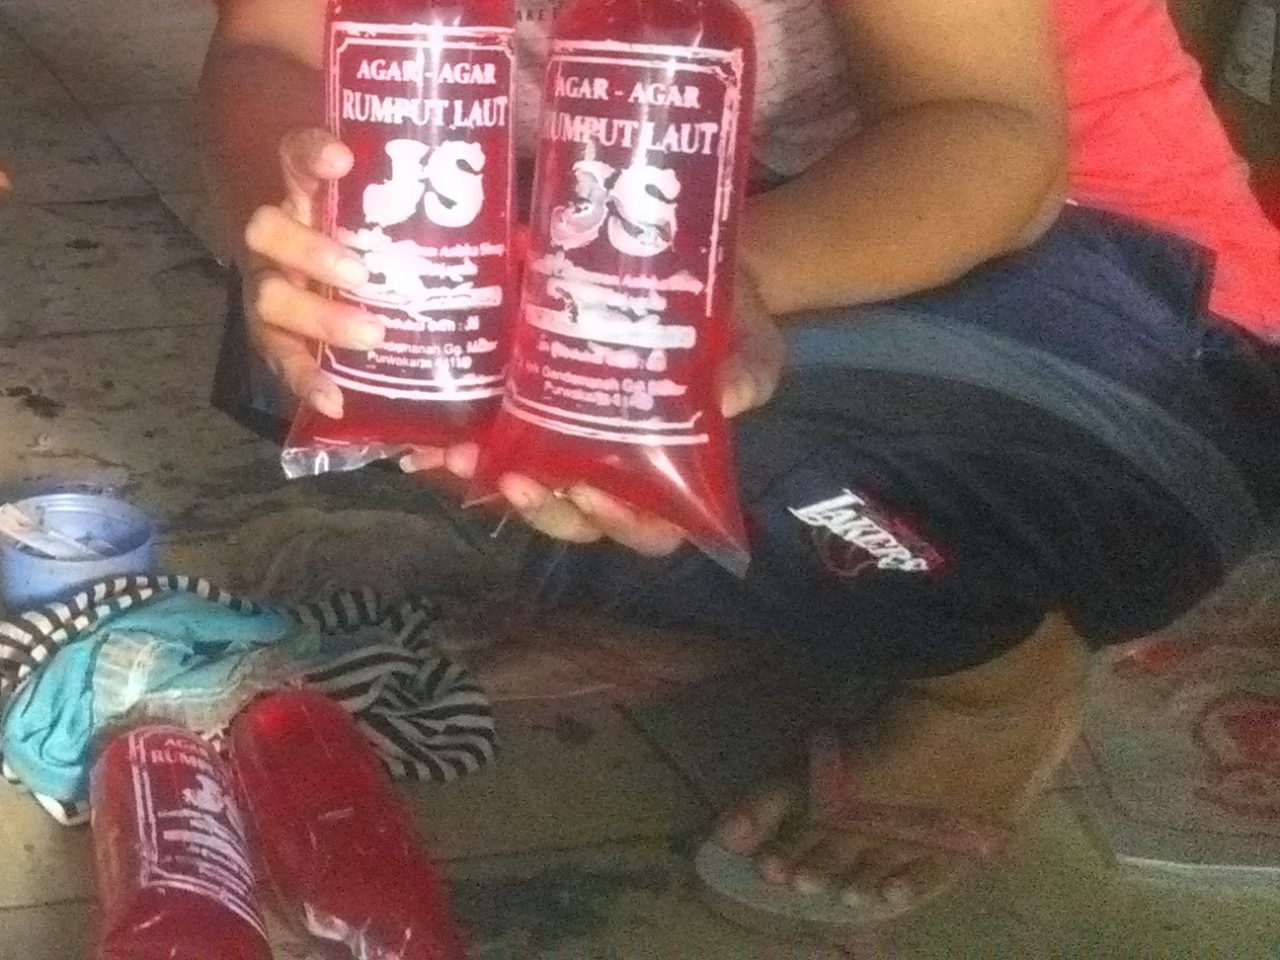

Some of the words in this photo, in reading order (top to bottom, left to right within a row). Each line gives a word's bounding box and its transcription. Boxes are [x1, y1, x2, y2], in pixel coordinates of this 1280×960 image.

[357, 59, 420, 84] AGAR
[437, 62, 496, 85] AGAR
[342, 89, 449, 126] RUMPUT
[451, 96, 508, 127] LAUT
[555, 76, 609, 101] AGAR
[628, 81, 701, 109] AGAR
[643, 121, 718, 155] LAUT
[362, 138, 486, 228] JS
